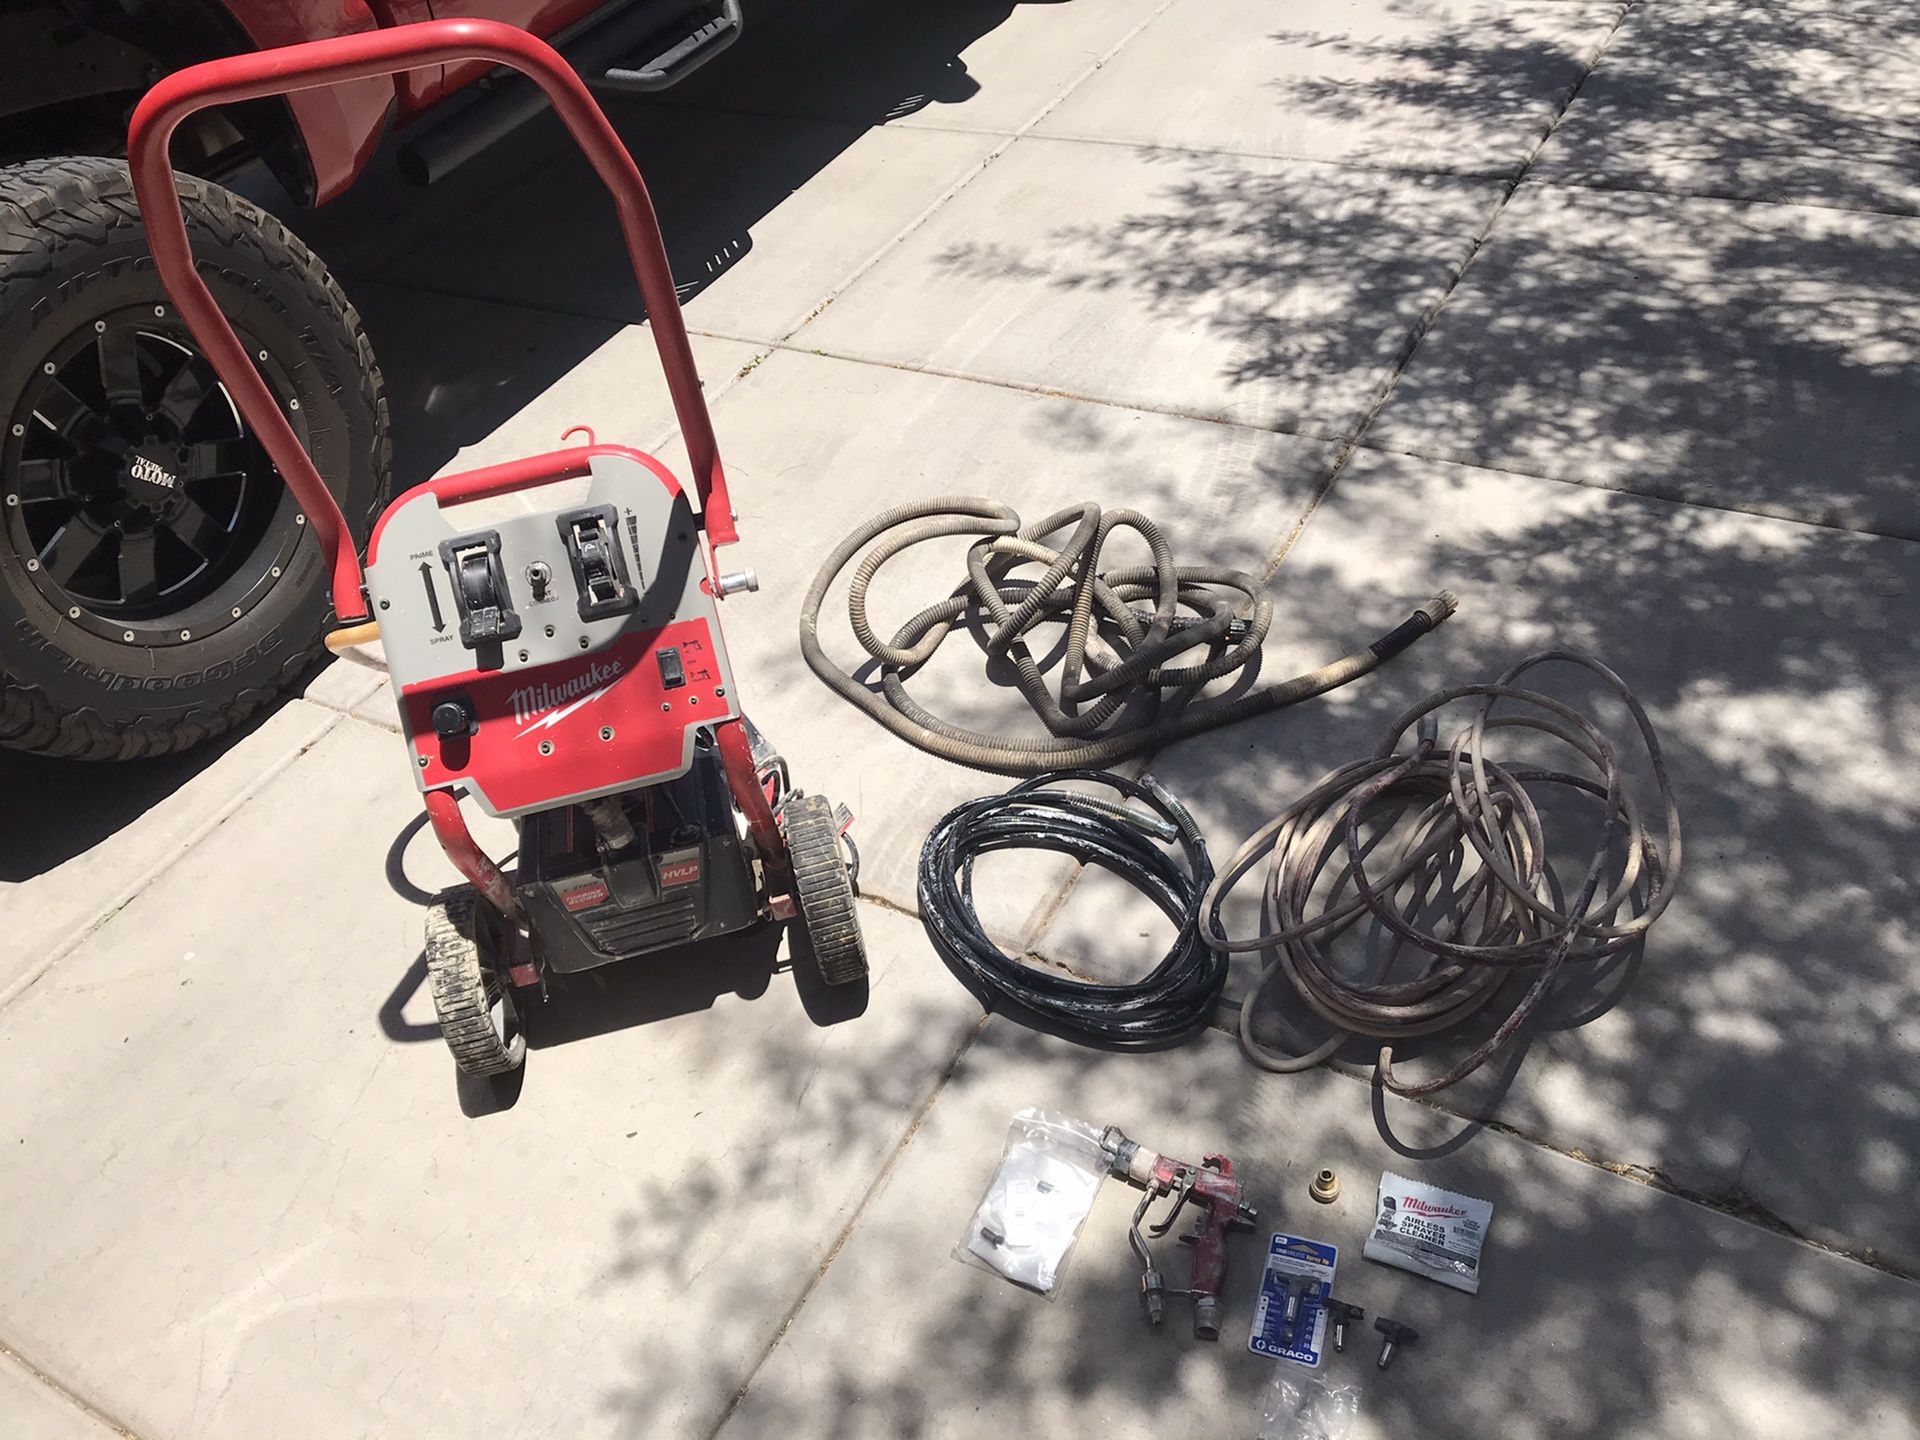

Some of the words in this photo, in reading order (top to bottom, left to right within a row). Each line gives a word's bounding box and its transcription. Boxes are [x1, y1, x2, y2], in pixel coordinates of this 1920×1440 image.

[130, 464, 177, 489] MOTO
[409, 550, 434, 560] PRIME
[430, 634, 454, 646] SPRAY
[504, 660, 624, 726] Milwaukee
[662, 865, 698, 880] HVLP
[1400, 1220, 1446, 1241] SPRAYER
[1404, 1215, 1446, 1234] AIRLESS
[1399, 1227, 1446, 1247] CLEANER
[1268, 1344, 1314, 1362] GRACO
